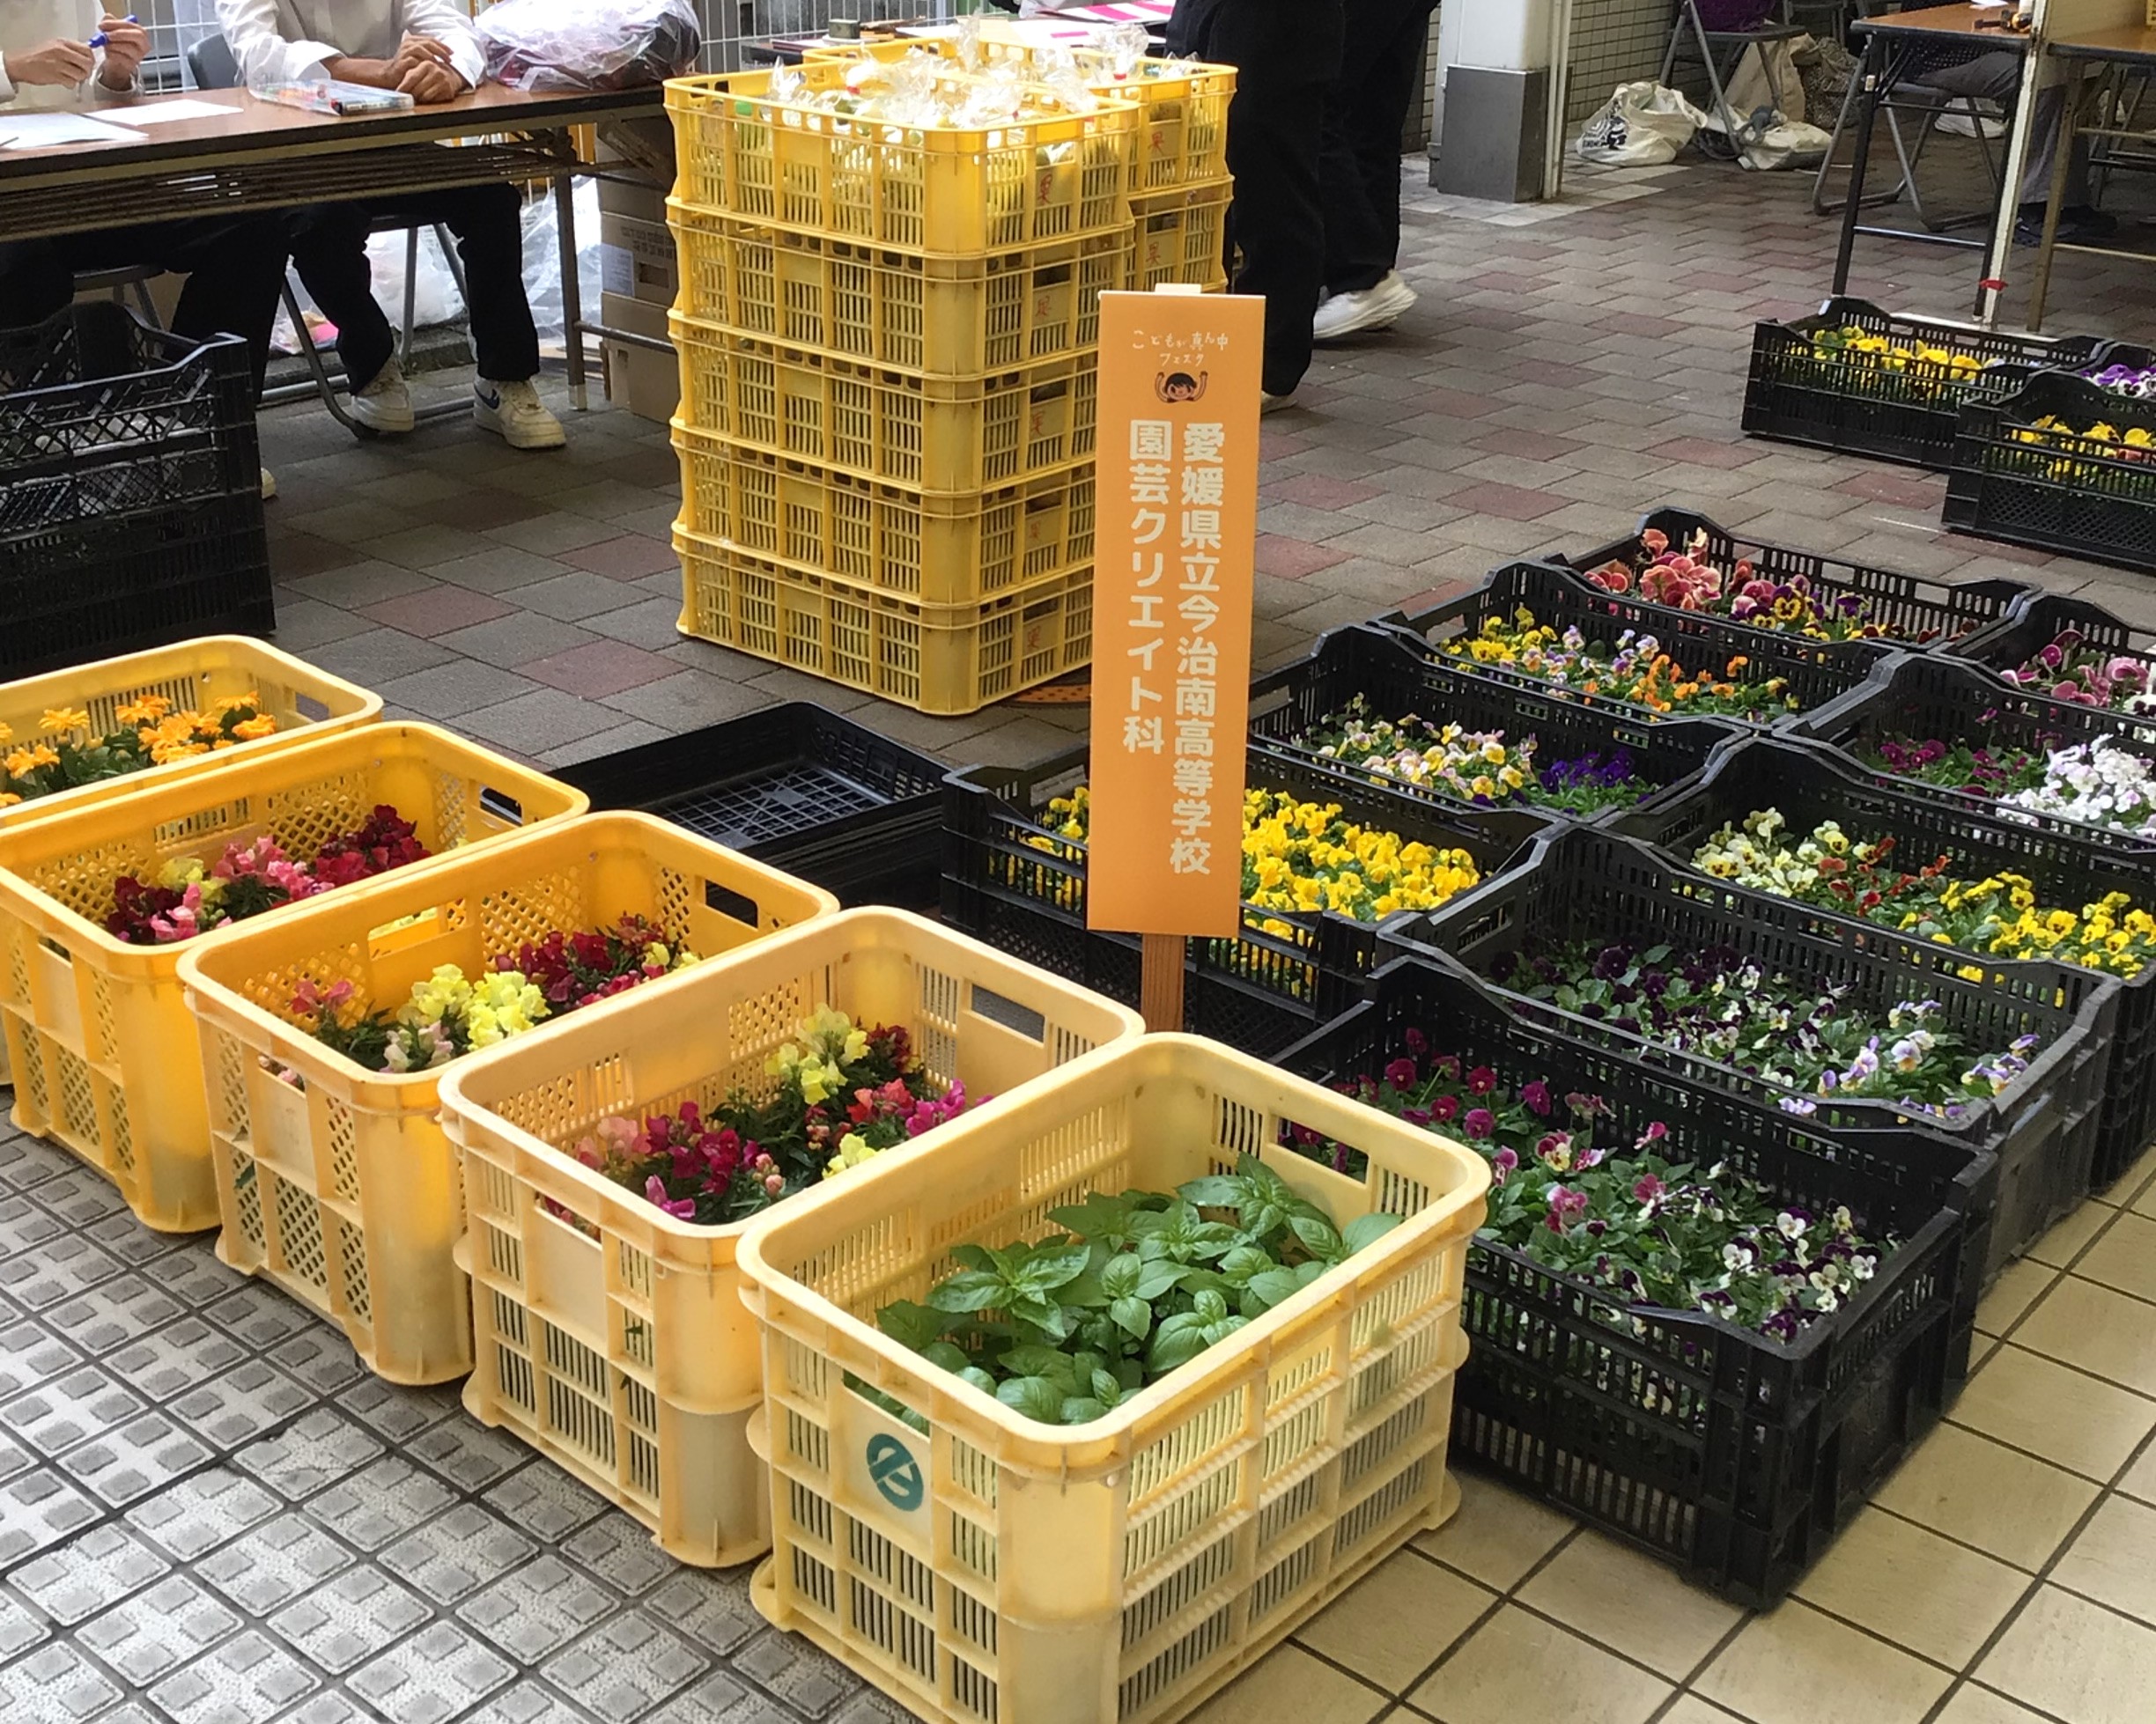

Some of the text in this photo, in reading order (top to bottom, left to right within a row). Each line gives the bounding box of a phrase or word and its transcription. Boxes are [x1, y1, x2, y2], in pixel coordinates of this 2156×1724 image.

[1132, 330, 1229, 351] こどもが真ん中
[1122, 420, 1172, 755] 園芸クリエイト科
[1170, 423, 1225, 874] 愛媛県立今治南高等学校
